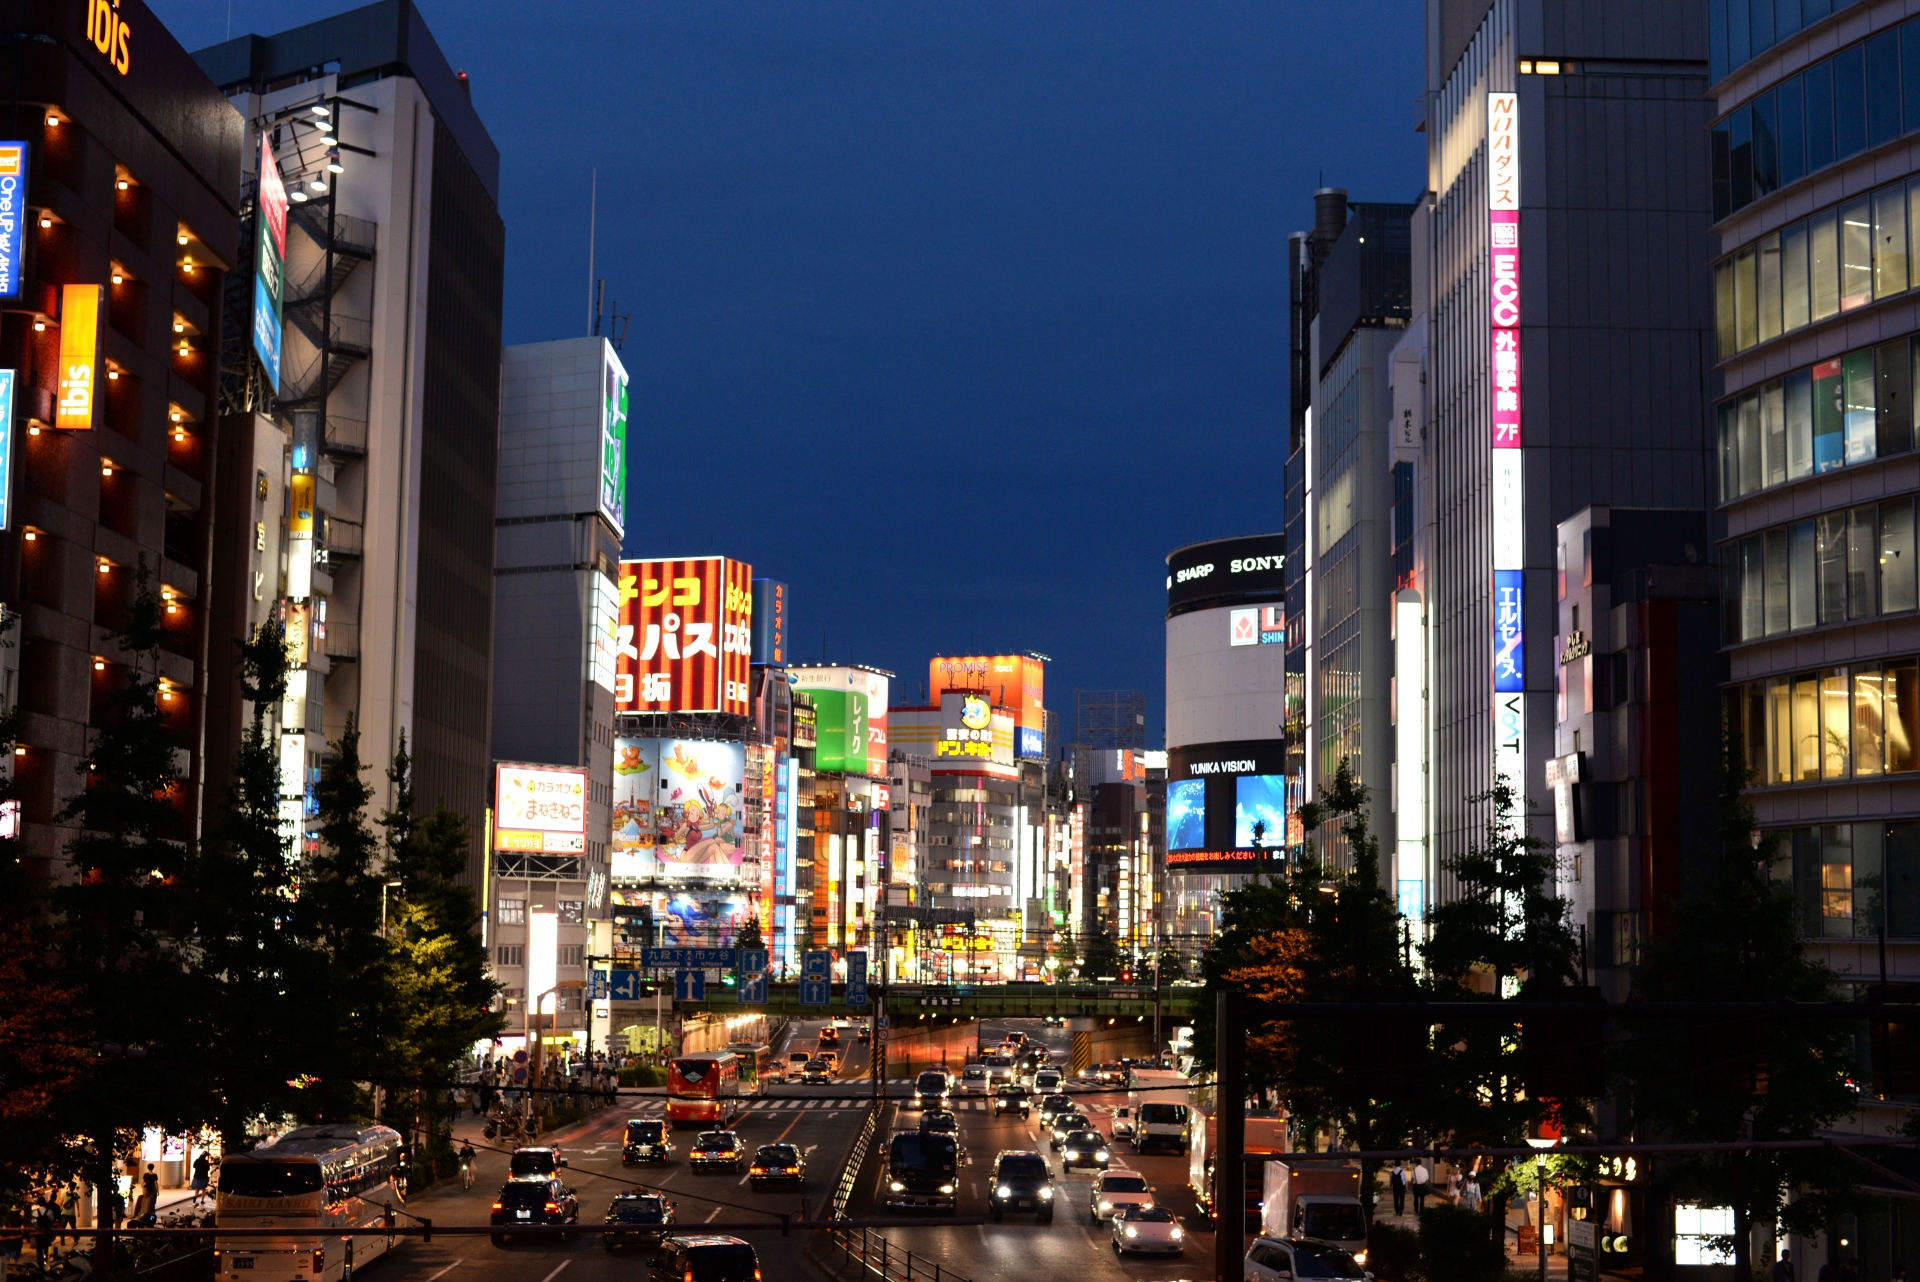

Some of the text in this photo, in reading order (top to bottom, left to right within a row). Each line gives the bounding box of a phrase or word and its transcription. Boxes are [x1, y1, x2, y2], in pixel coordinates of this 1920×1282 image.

[87, 0, 130, 76] ibis
[1493, 255, 1518, 327] ECC
[1495, 331, 1518, 412] 外語学院
[60, 364, 91, 416] ibis
[1495, 423, 1518, 442] 7F
[1176, 563, 1214, 583] SHARP
[1230, 555, 1286, 573] SONY
[725, 581, 752, 615] パチンコ
[1498, 587, 1517, 679] エルセーヌ
[940, 662, 989, 673] PROMISE
[801, 674, 831, 683] 新生銀行
[852, 696, 861, 754] レイク
[868, 727, 886, 744] アコム
[1190, 760, 1256, 775] YUNIKA VISION
[537, 781, 571, 793] カラオケ
[526, 798, 581, 821] まねきねこ
[648, 950, 683, 960] 九段下
[855, 954, 864, 1002] 新宿駅東口
[225, 1198, 310, 1208] SAIKI KANKO
